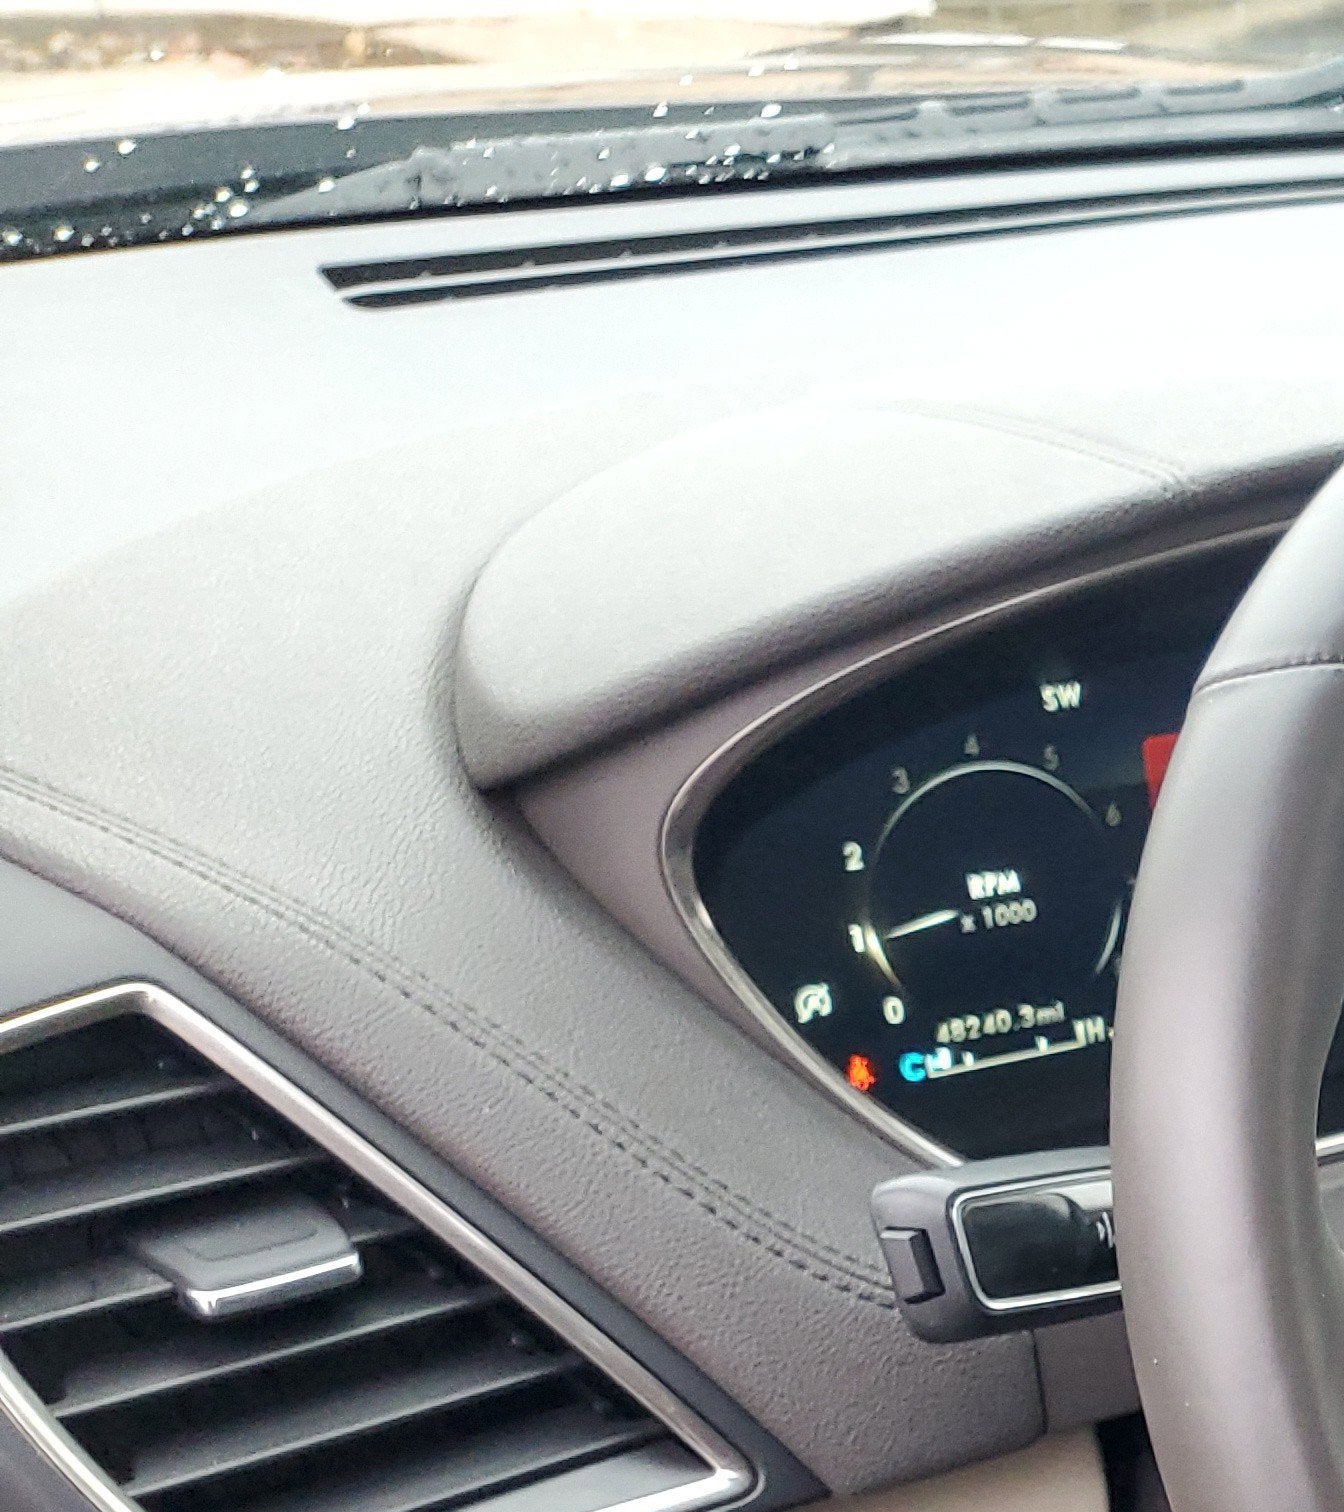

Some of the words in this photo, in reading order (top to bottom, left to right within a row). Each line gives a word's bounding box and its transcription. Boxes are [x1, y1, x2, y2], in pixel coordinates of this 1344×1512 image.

[1040, 682, 1082, 712] SW
[964, 734, 980, 755] 4
[892, 768, 910, 793] 3
[843, 842, 865, 871] 2
[967, 871, 1021, 900] RPM
[982, 900, 1038, 929] 1000
[849, 927, 867, 952] 1
[883, 996, 905, 1025] 0
